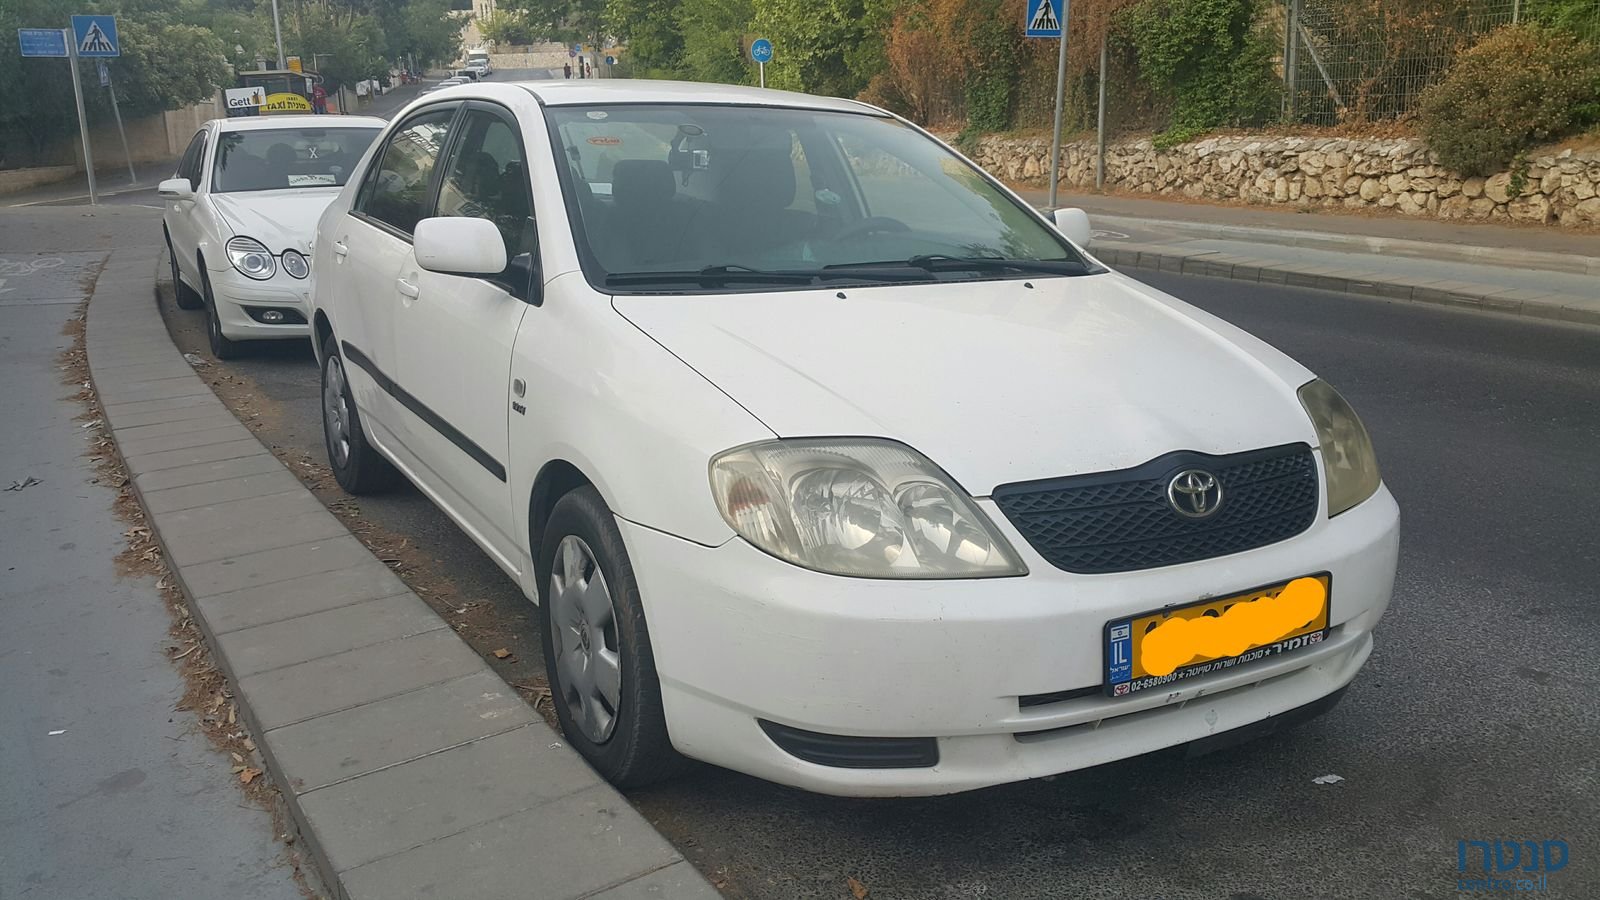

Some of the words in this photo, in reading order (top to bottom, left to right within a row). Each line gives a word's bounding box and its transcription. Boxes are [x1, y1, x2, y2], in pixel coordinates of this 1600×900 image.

[229, 97, 251, 107] Gett
[267, 101, 286, 110] TAXI
[1272, 635, 1309, 653] זמיר
[1114, 641, 1128, 665] IL
